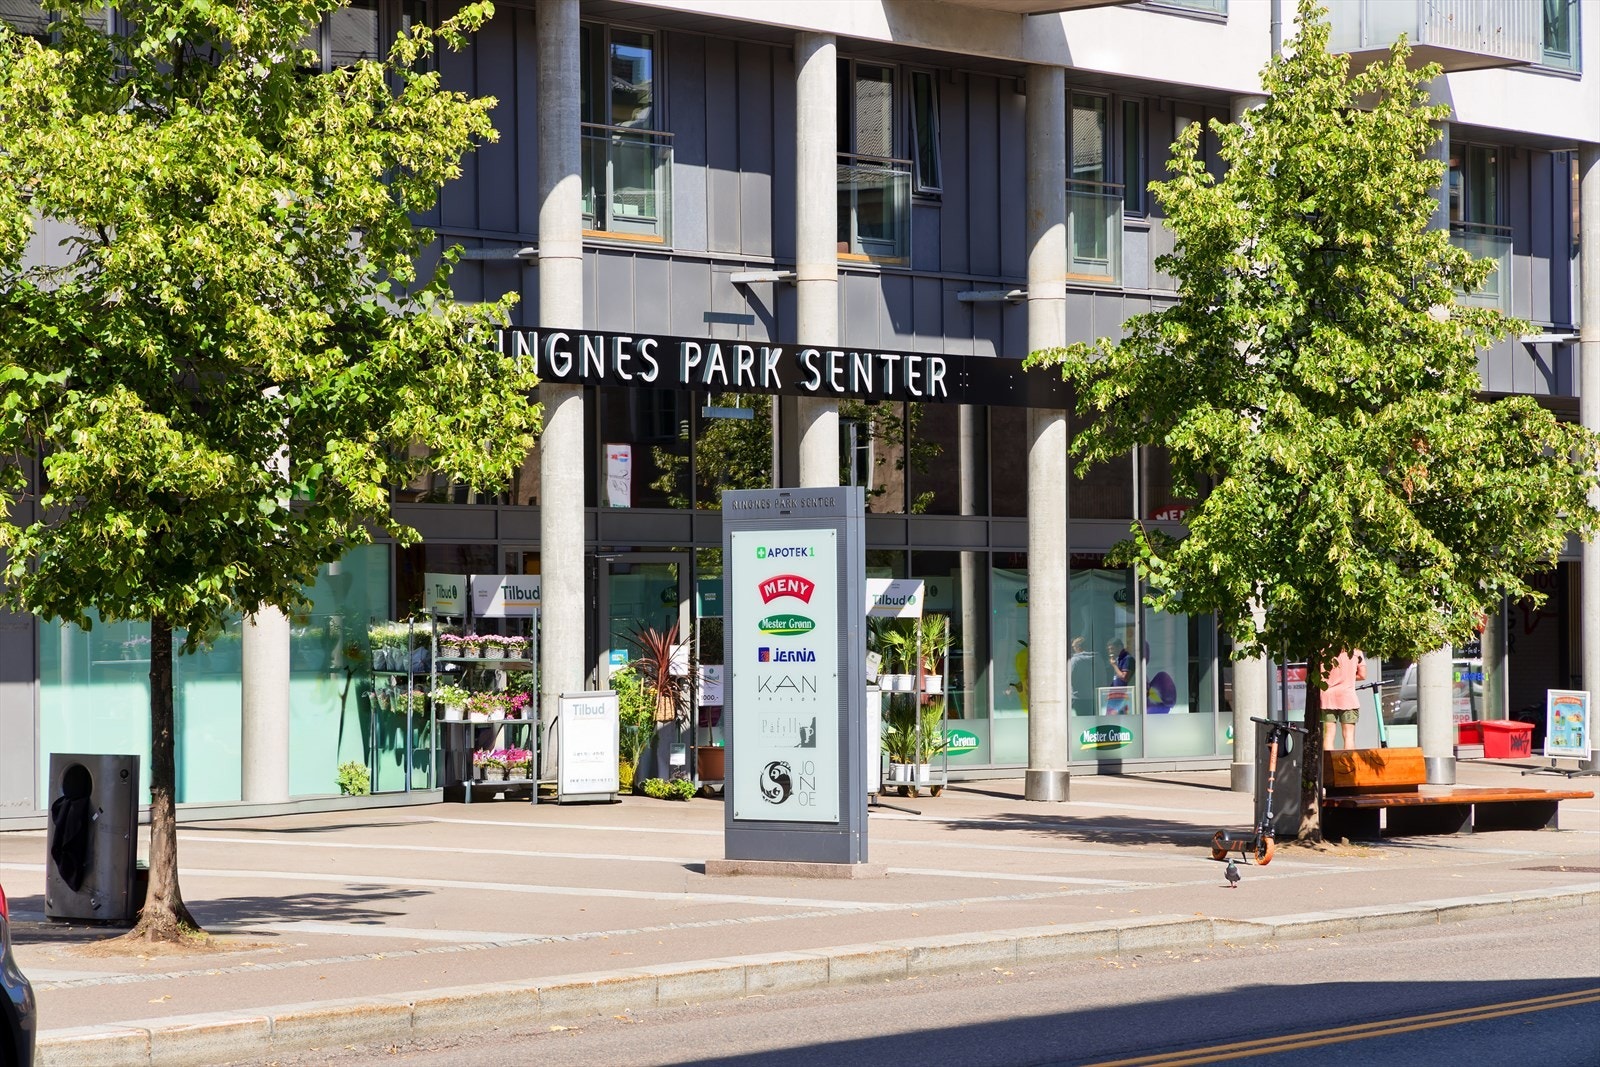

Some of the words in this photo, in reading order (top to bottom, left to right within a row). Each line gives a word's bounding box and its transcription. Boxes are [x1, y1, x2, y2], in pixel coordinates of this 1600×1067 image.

[465, 329, 659, 384] INGNES
[680, 340, 783, 390] PARK
[796, 348, 949, 398] SENTER
[774, 498, 798, 509] PARK
[801, 497, 835, 508] SENTER
[767, 547, 808, 558] APOTEK
[809, 547, 815, 557] 1
[501, 585, 541, 600] Tilbud
[764, 579, 810, 596] MENY
[872, 594, 906, 606] Tilbud
[762, 618, 787, 630] Mester
[758, 675, 817, 694] KAN
[572, 703, 605, 716] Tilbud
[1083, 730, 1106, 743] Mester
[798, 760, 815, 776] JO
[799, 776, 816, 791] N
[798, 791, 817, 807] OE
